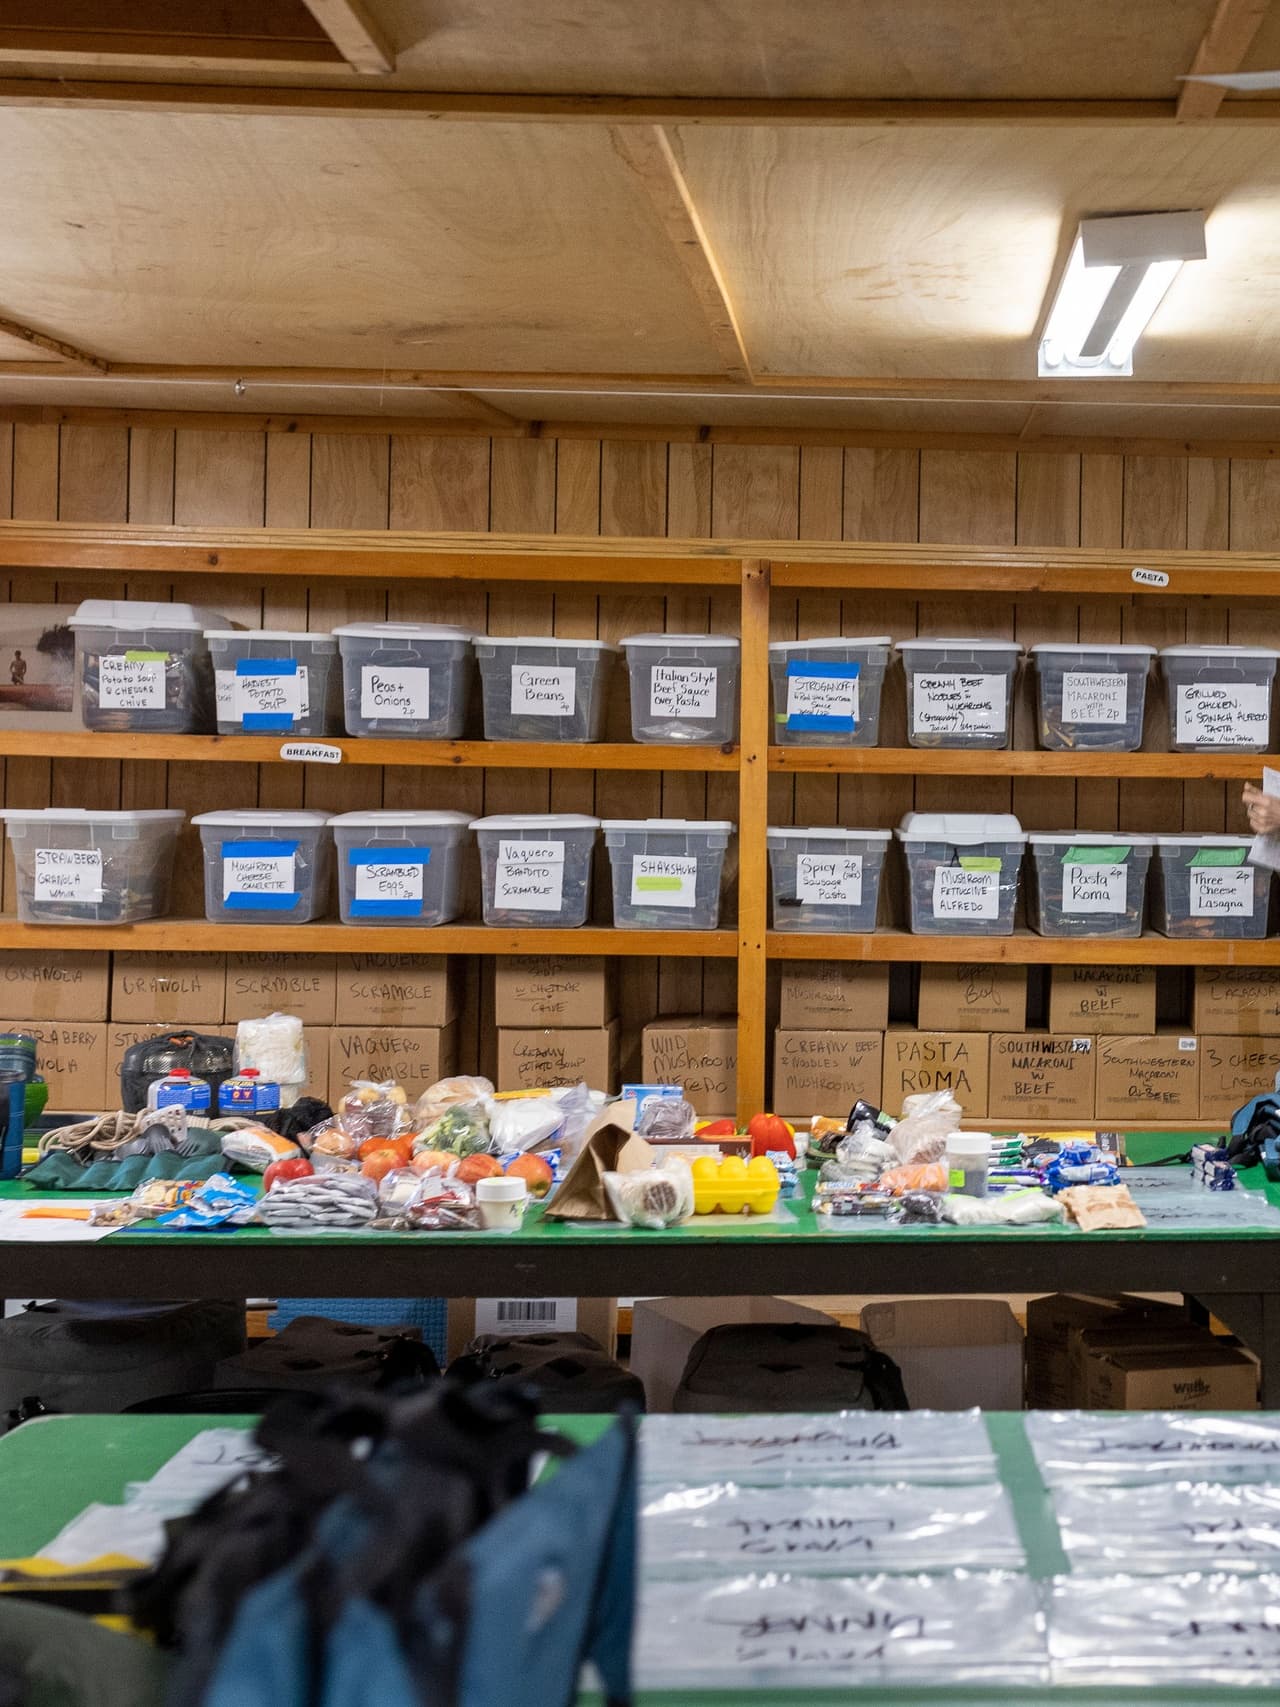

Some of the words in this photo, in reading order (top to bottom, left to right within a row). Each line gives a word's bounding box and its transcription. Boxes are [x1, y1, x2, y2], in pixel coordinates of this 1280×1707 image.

[1135, 571, 1164, 583] PASTA
[102, 660, 145, 672] CREAMY
[519, 670, 560, 687] Green
[655, 668, 689, 683] Italian
[1066, 677, 1128, 688] SOUTHWESTERN
[249, 687, 284, 699] POTATO
[525, 689, 565, 701] Beans
[653, 682, 677, 694] Beef
[680, 685, 710, 697] Sauce
[1067, 691, 1118, 701] MACARONI
[120, 698, 148, 707] CHIVE
[259, 697, 287, 711] SOUP
[374, 694, 411, 706] Onions
[676, 694, 701, 708] Pasta
[1071, 710, 1102, 720] BEEF
[286, 748, 340, 760] BREAKFAST
[505, 846, 554, 863] Vaquero
[231, 861, 279, 873] MUSHROOM
[366, 865, 419, 879] SCRAMBLED
[505, 865, 549, 877] BANDITO
[801, 856, 836, 877] Spicy
[1071, 867, 1108, 886] Pasta
[1193, 871, 1224, 885] Three
[503, 884, 553, 896] SCRAMBLE
[818, 888, 847, 900] Pasta
[1072, 886, 1111, 901] Roma
[1200, 885, 1237, 896] Cheese
[940, 900, 983, 911] ALFREDO
[1198, 896, 1243, 912] Lasagna
[5, 964, 82, 984] GRANOLA
[122, 976, 204, 995] GRANOLA
[350, 983, 432, 1000] SCRAMBLE
[1080, 997, 1122, 1013] BEEF
[339, 1037, 421, 1058] VAQUERO
[784, 1038, 848, 1054] CREAMY
[896, 1041, 970, 1063] PASTA
[791, 1057, 839, 1069] NOODLES
[1012, 1057, 1078, 1071] MACARONI
[1103, 1049, 1196, 1068] SOUTHWESTERN
[1207, 1049, 1222, 1067] 3
[1229, 1053, 1280, 1068] CHEES
[901, 1069, 972, 1093] ROMA
[1129, 1068, 1179, 1081] MACARONI
[1014, 1081, 1055, 1096] BEEF
